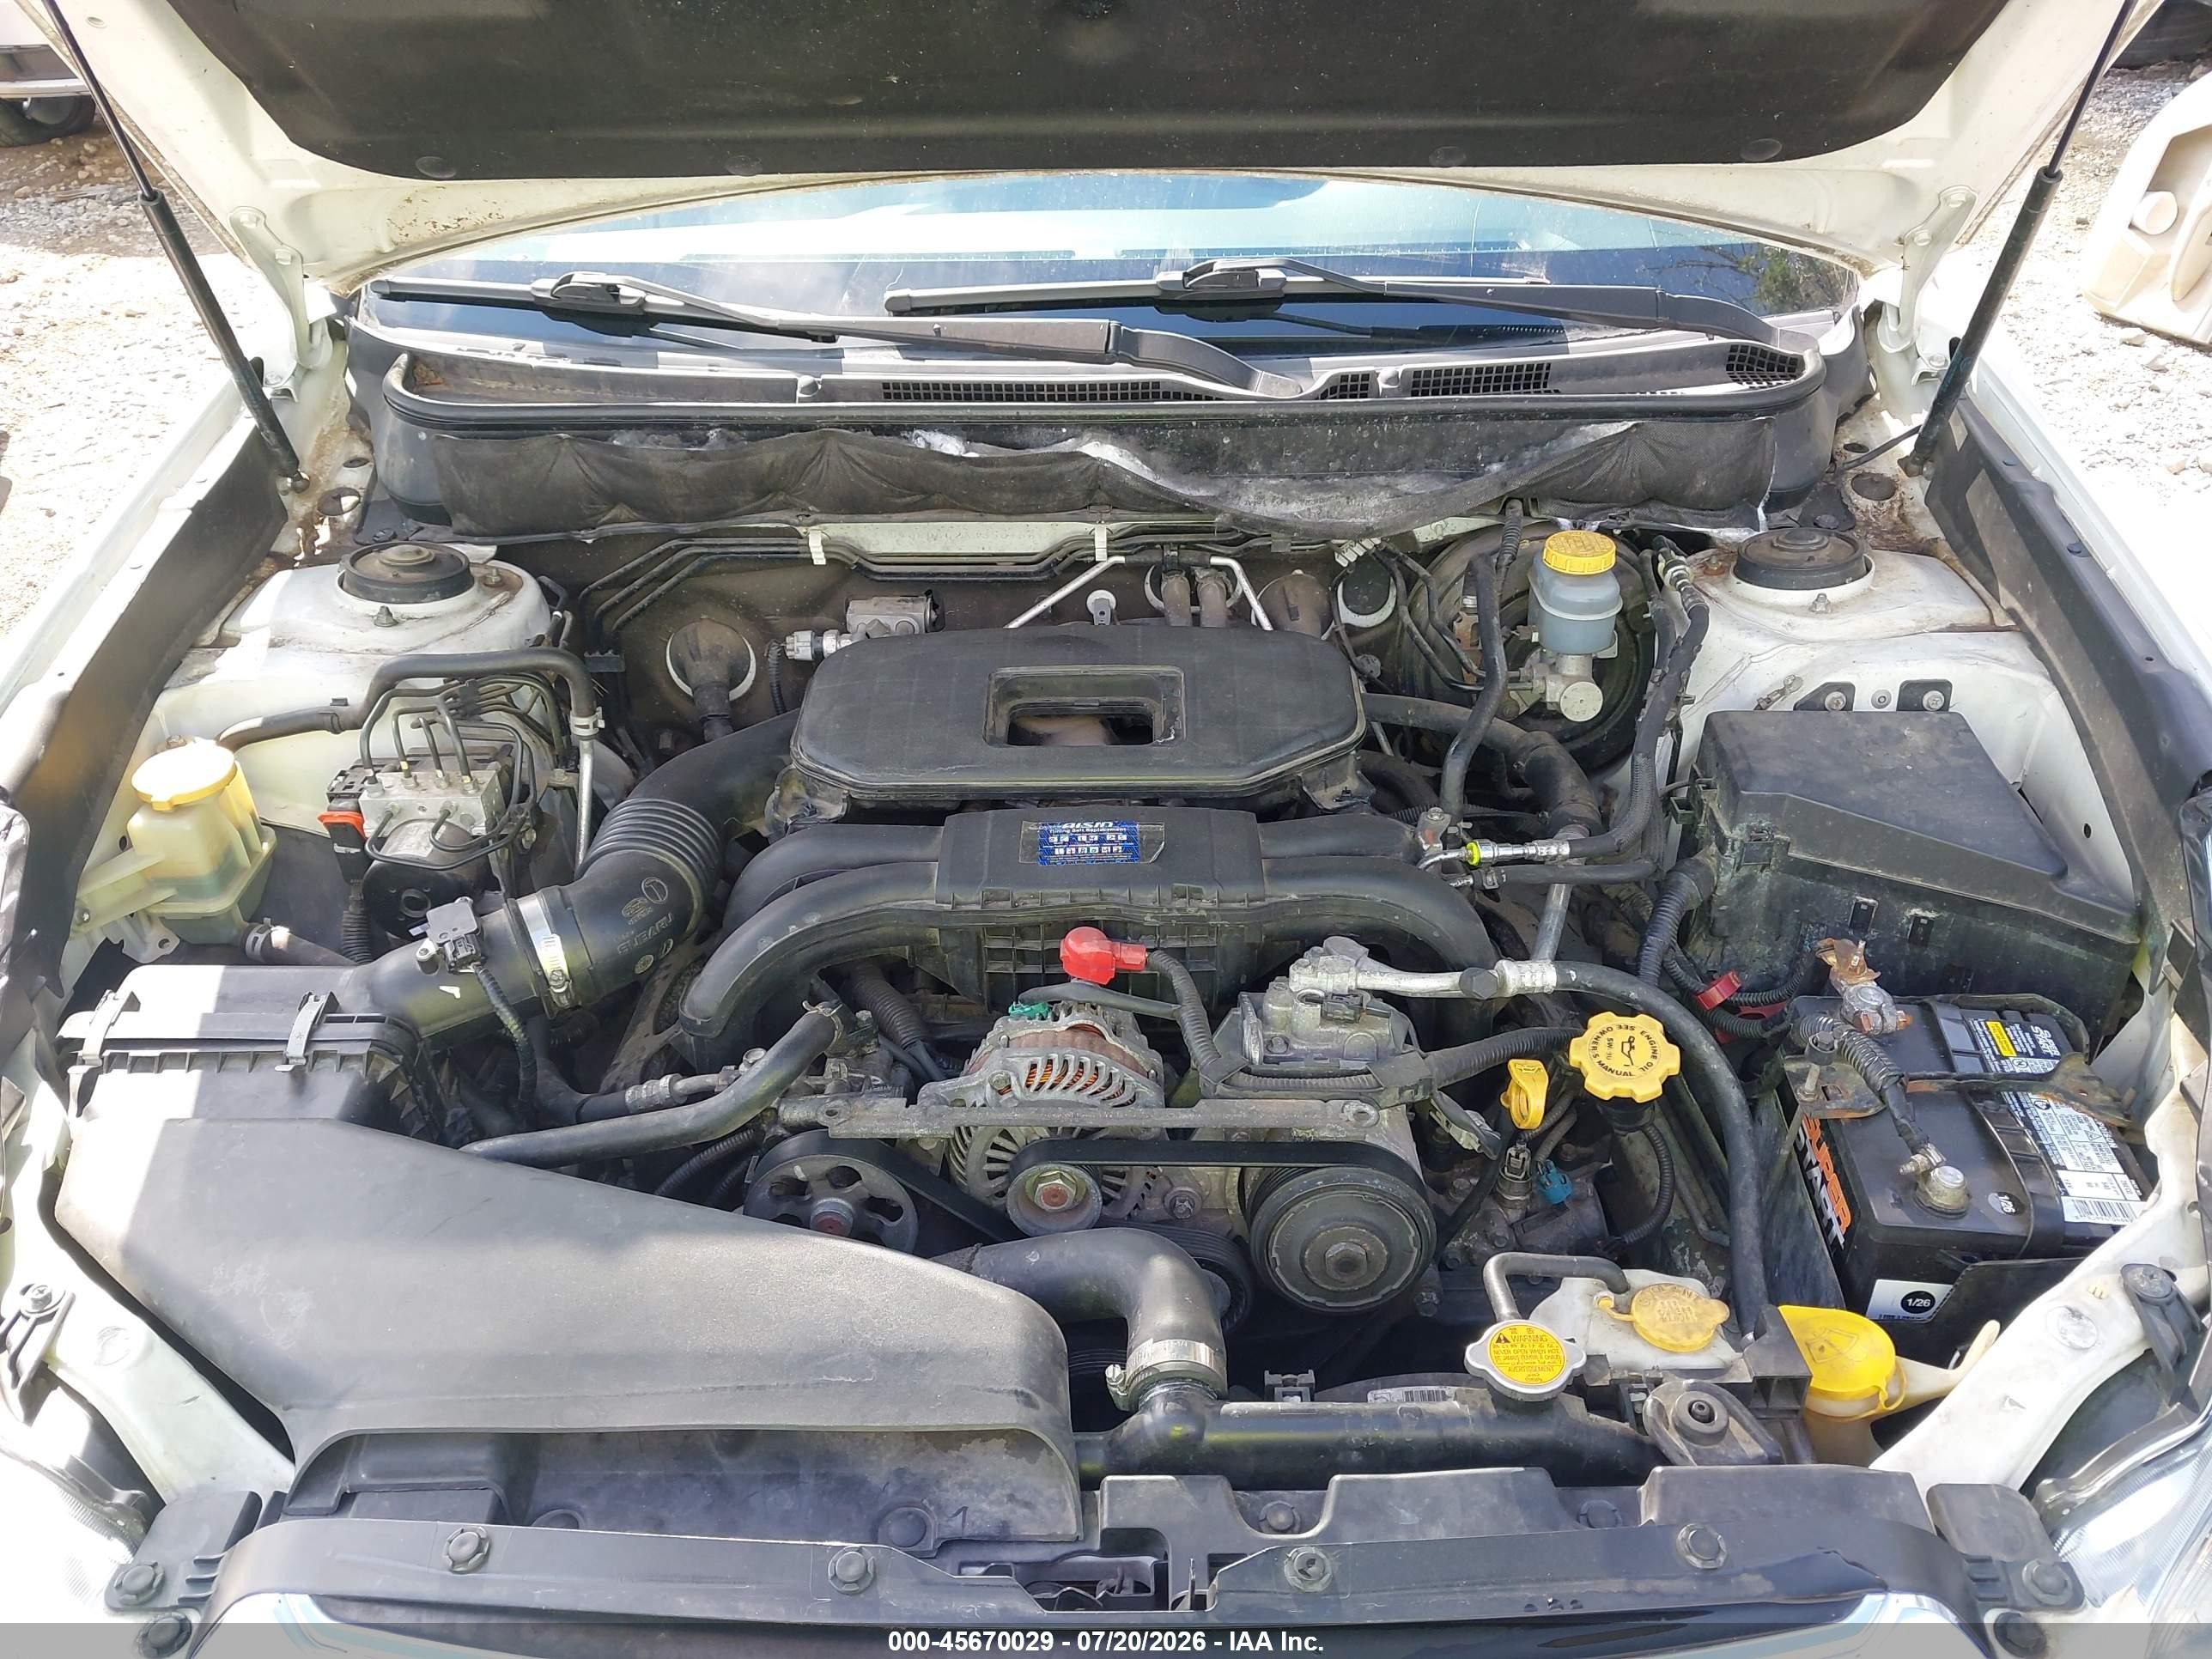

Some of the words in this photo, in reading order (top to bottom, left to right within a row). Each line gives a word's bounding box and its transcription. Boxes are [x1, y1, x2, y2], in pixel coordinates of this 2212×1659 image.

[1640, 1030, 1658, 1060] ENGINE
[2030, 1024, 2050, 1055] START
[2041, 1029, 2061, 1057] SUPER
[1596, 1060, 1636, 1077] MANUAL
[1638, 1061, 1654, 1073] OIL
[1997, 1194, 2015, 1214] 1/26
[1907, 1298, 1931, 1307] 1/26
[1510, 1334, 1547, 1343] WARNING
